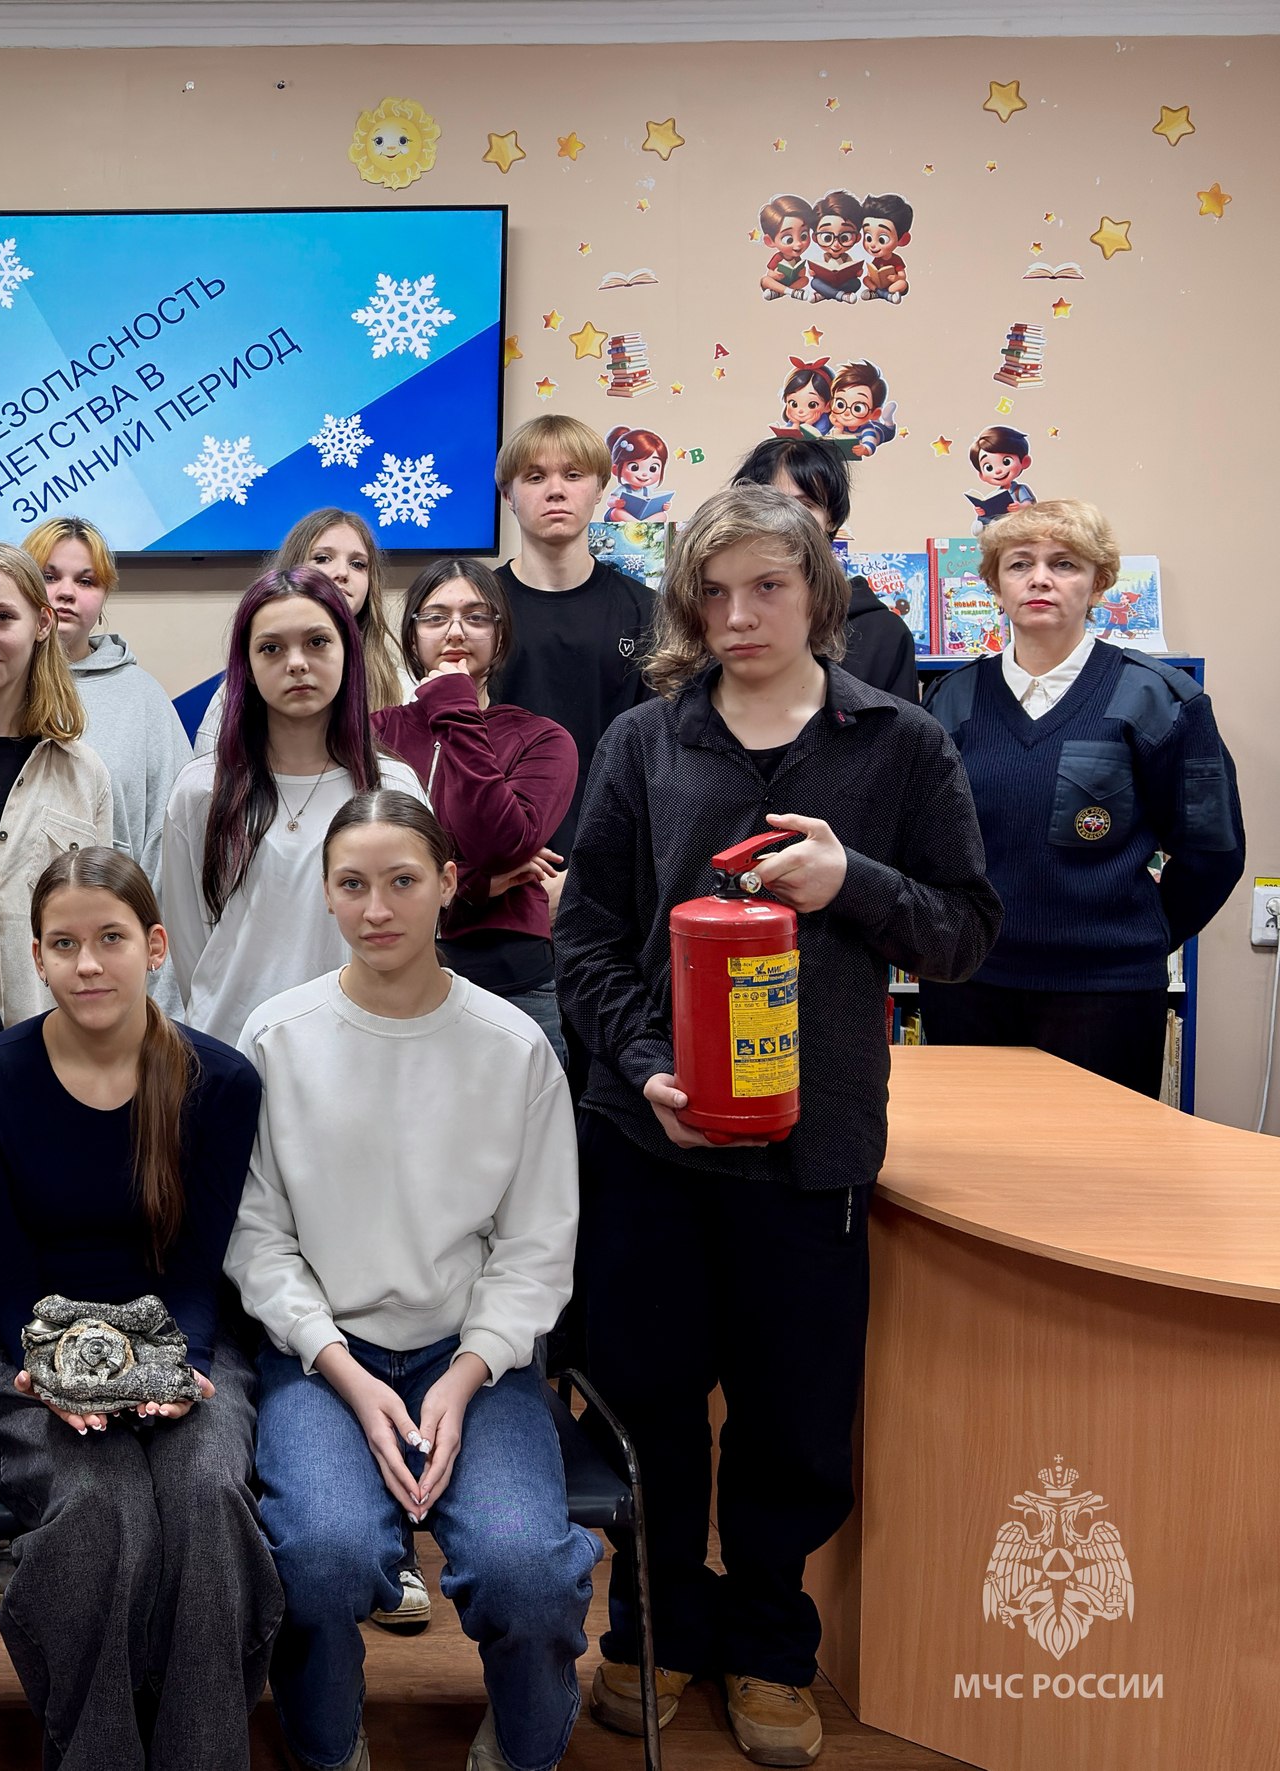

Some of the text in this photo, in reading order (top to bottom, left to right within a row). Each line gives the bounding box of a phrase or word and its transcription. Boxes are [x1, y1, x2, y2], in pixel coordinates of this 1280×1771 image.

[714, 343, 730, 359] А
[135, 362, 165, 392] В
[995, 396, 1014, 414] Б
[12, 326, 303, 524] ЗИМНИЙ ПЕРИОД
[689, 447, 705, 464] В
